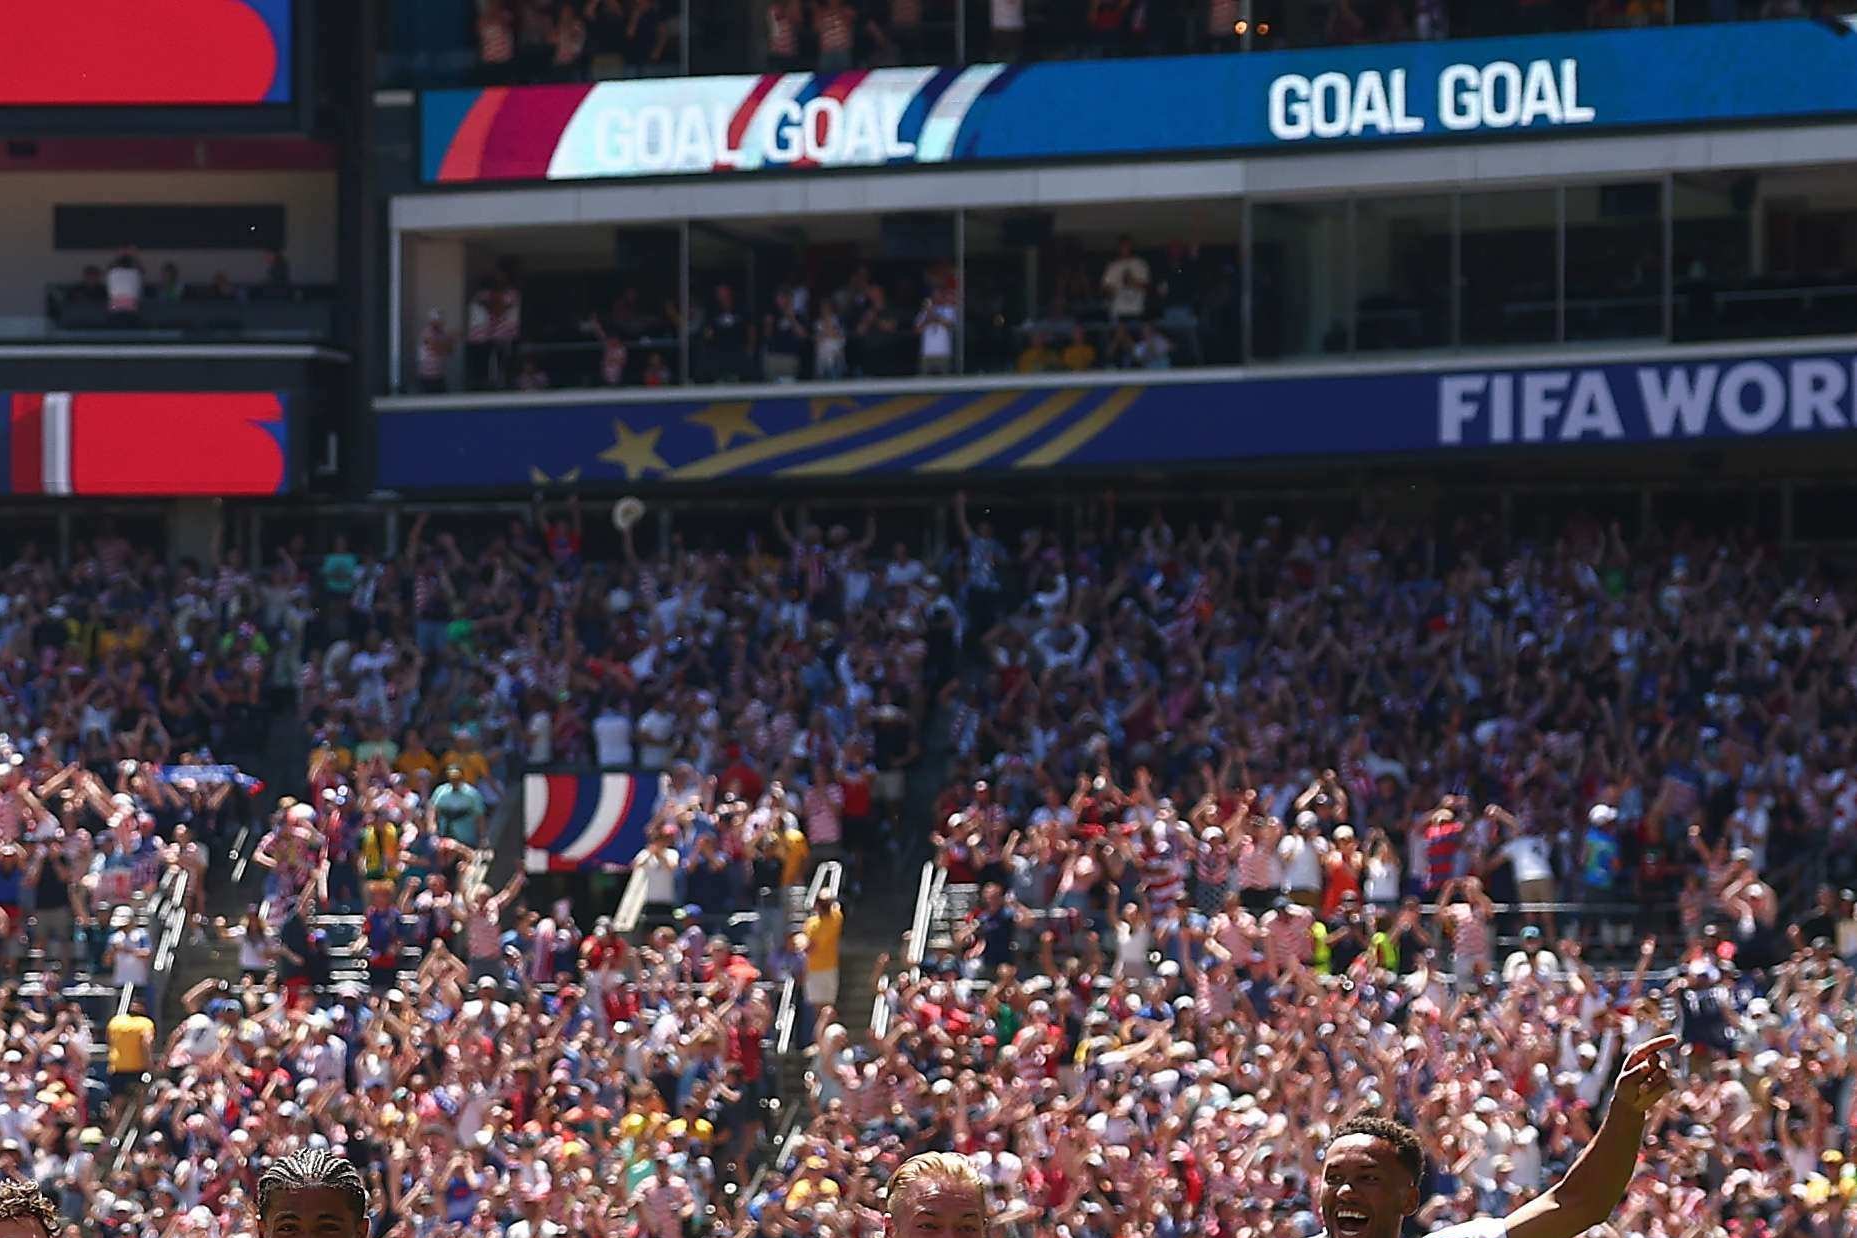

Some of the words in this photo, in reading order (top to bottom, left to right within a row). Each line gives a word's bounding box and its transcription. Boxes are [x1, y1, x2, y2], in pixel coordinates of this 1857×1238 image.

[595, 104, 740, 166] GOAL
[765, 96, 916, 163] GOAL
[1269, 68, 1424, 140] GOAL
[1438, 58, 1596, 131] GOAL
[1438, 369, 1626, 444] FIFA
[1637, 358, 1857, 437] WOR
